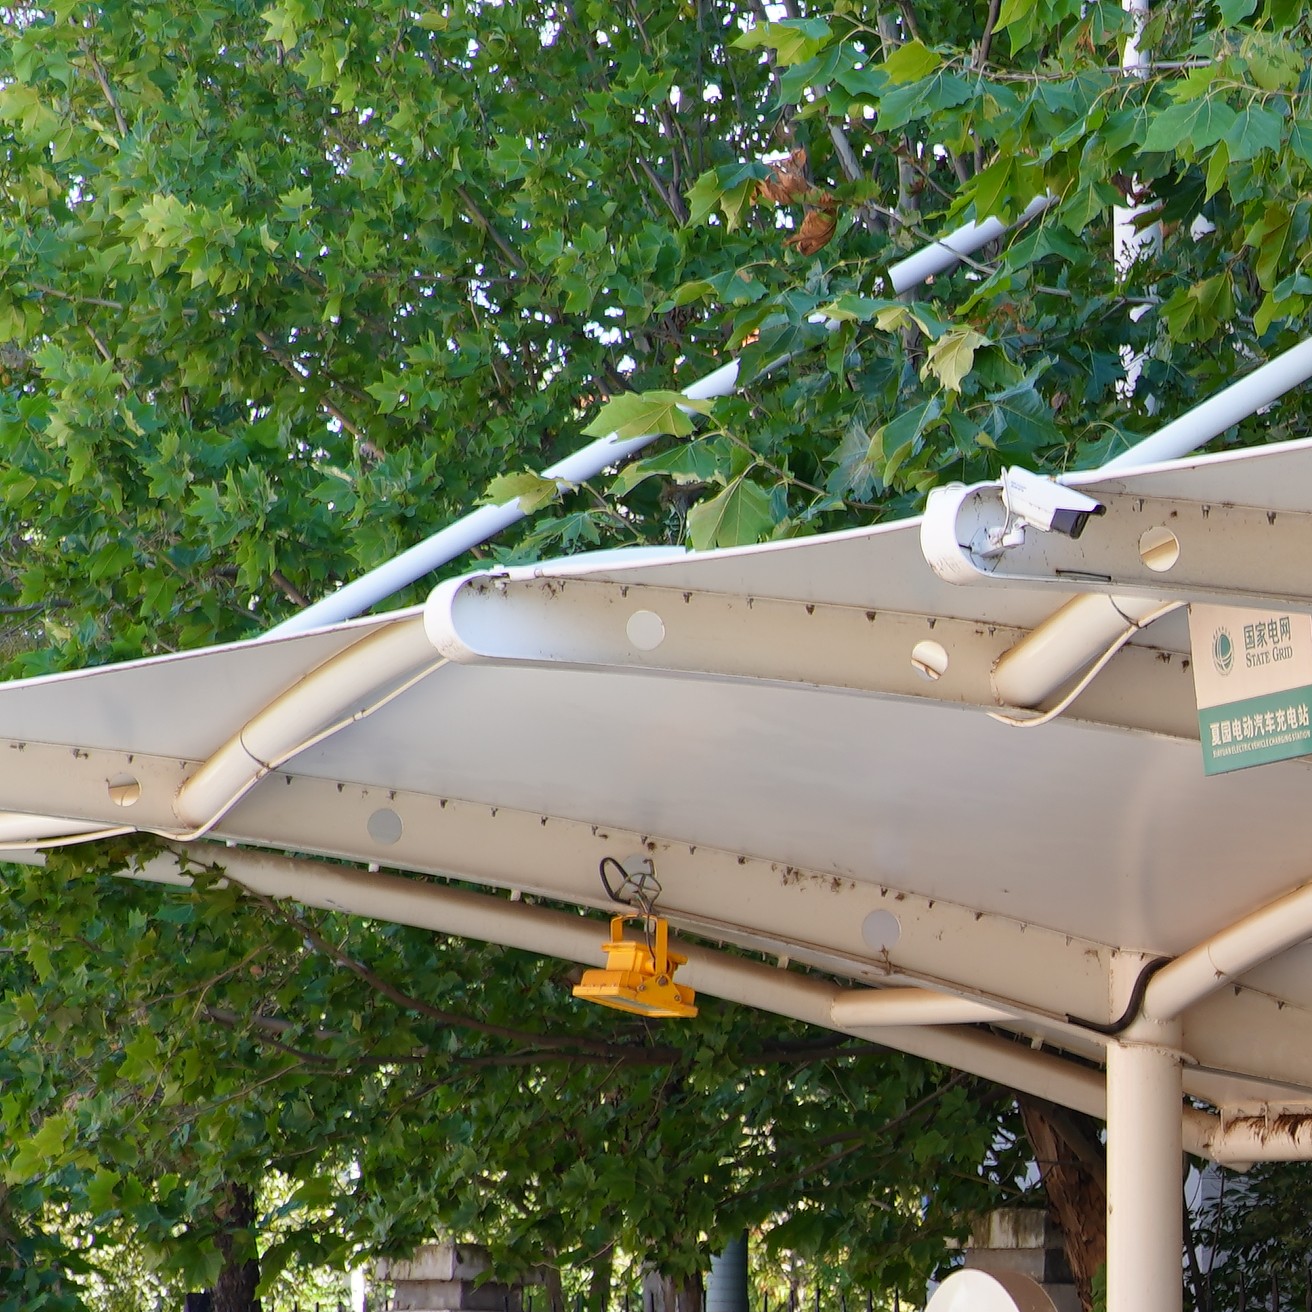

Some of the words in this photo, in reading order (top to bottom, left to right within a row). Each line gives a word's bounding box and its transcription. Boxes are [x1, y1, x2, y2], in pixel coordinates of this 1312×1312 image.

[1243, 616, 1291, 651] 国家电网
[1245, 650, 1270, 668] STATE
[1272, 645, 1293, 662] GRID
[1209, 704, 1310, 746] 夏园电动汽车充电站
